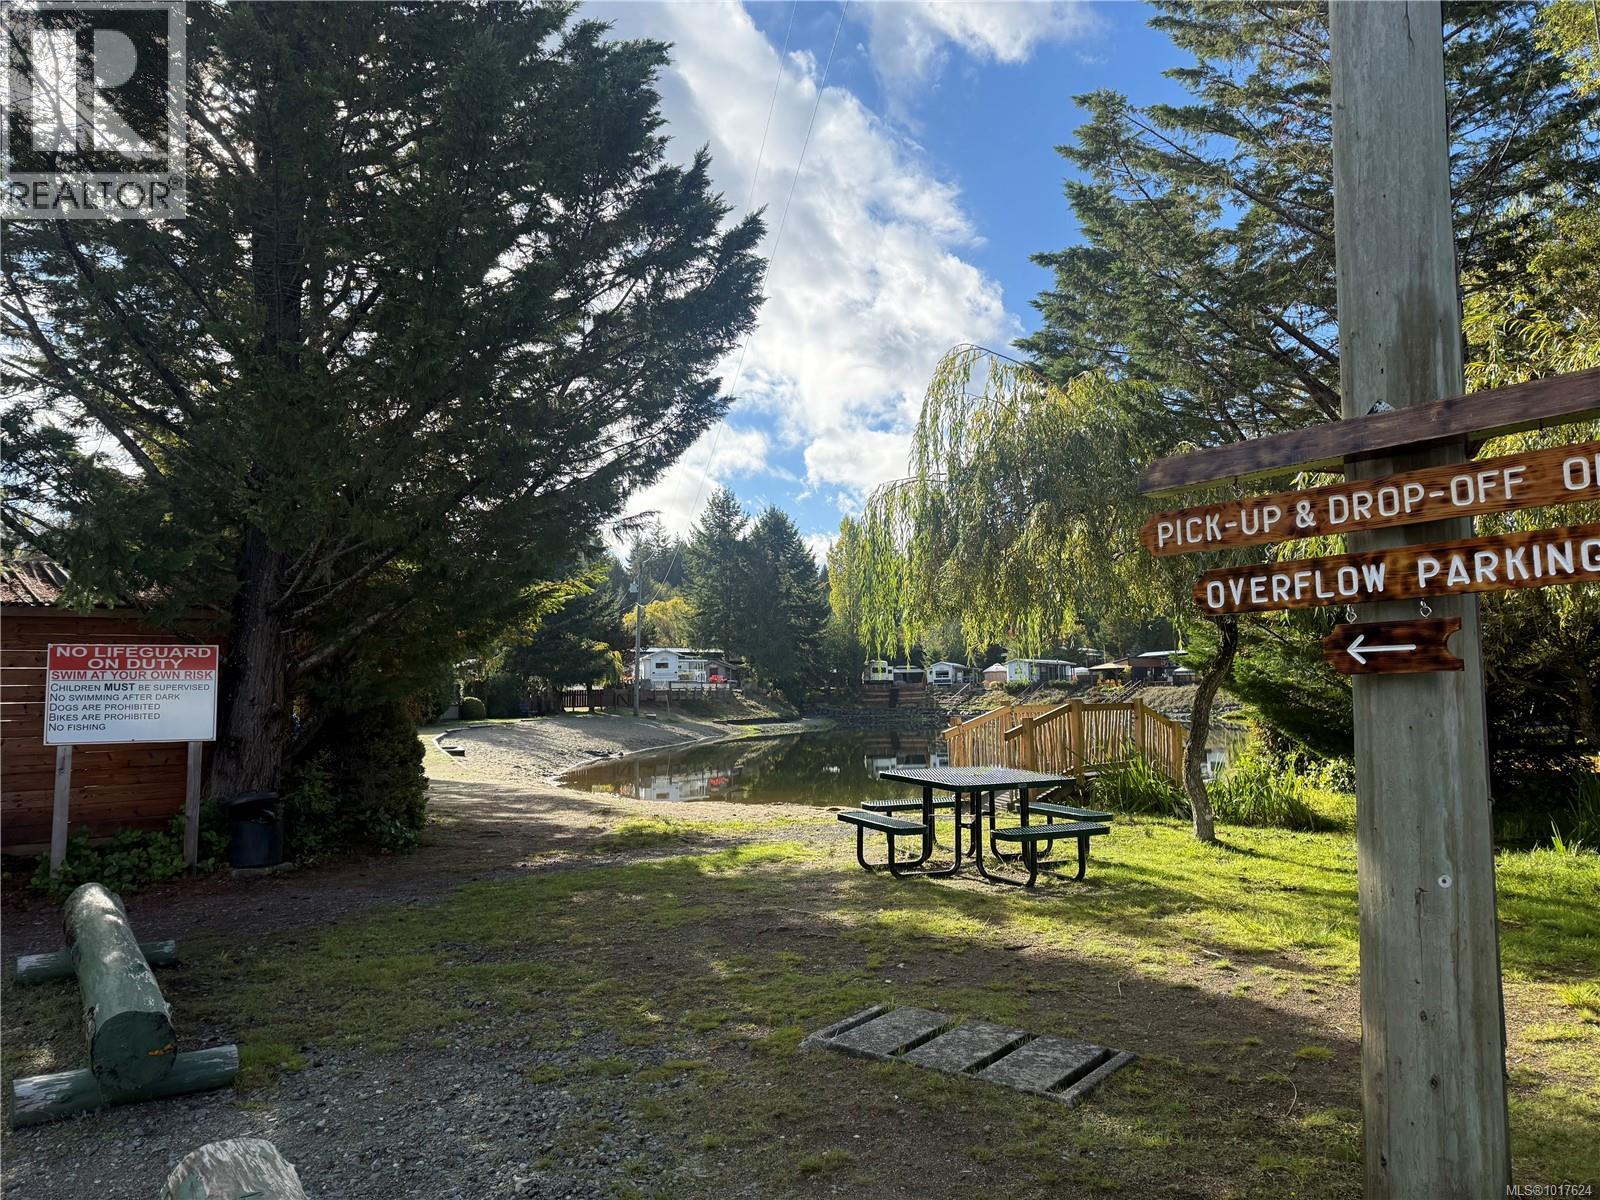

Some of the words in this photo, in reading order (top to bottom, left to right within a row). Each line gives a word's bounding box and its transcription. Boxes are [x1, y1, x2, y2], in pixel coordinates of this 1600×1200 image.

[1157, 504, 1282, 548] PICK-UP
[1295, 499, 1317, 529] &
[1328, 465, 1528, 525] DROP-OFF
[1206, 562, 1386, 609] OVERFLOW
[1417, 538, 1600, 589] PARKING
[56, 646, 87, 658] NO
[94, 647, 211, 658] LIFEGUARD
[87, 659, 119, 670] ON
[126, 659, 183, 670] DUTY
[51, 671, 87, 681] SWIM
[90, 671, 107, 681] AT
[111, 671, 147, 681] YOUR
[150, 671, 181, 680] OWN
[184, 670, 213, 680] RISK
[104, 683, 135, 692] MUST
[81, 703, 101, 711] ARE
[81, 713, 101, 721] ARE
[67, 723, 106, 731] FISHING
